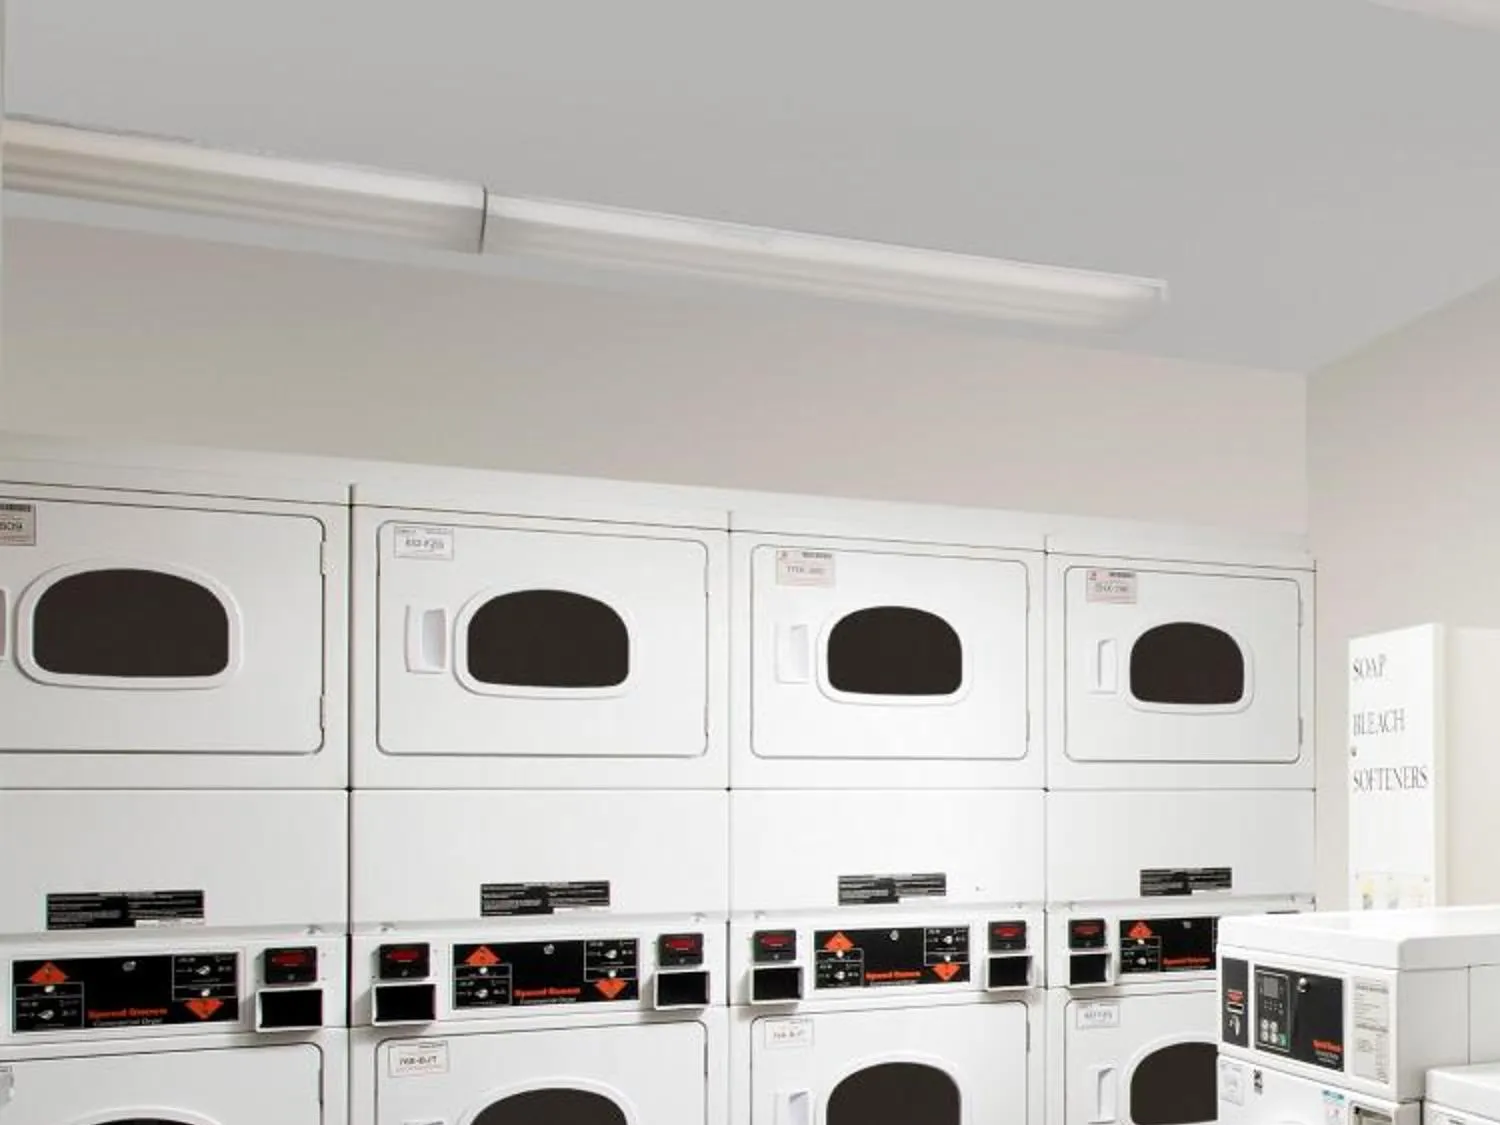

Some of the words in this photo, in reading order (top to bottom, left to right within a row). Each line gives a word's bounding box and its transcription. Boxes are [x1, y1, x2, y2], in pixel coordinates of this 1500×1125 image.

[1352, 654, 1386, 681] SOAP
[1353, 708, 1405, 737] BLEACH
[1353, 765, 1428, 793] SOFTENERS
